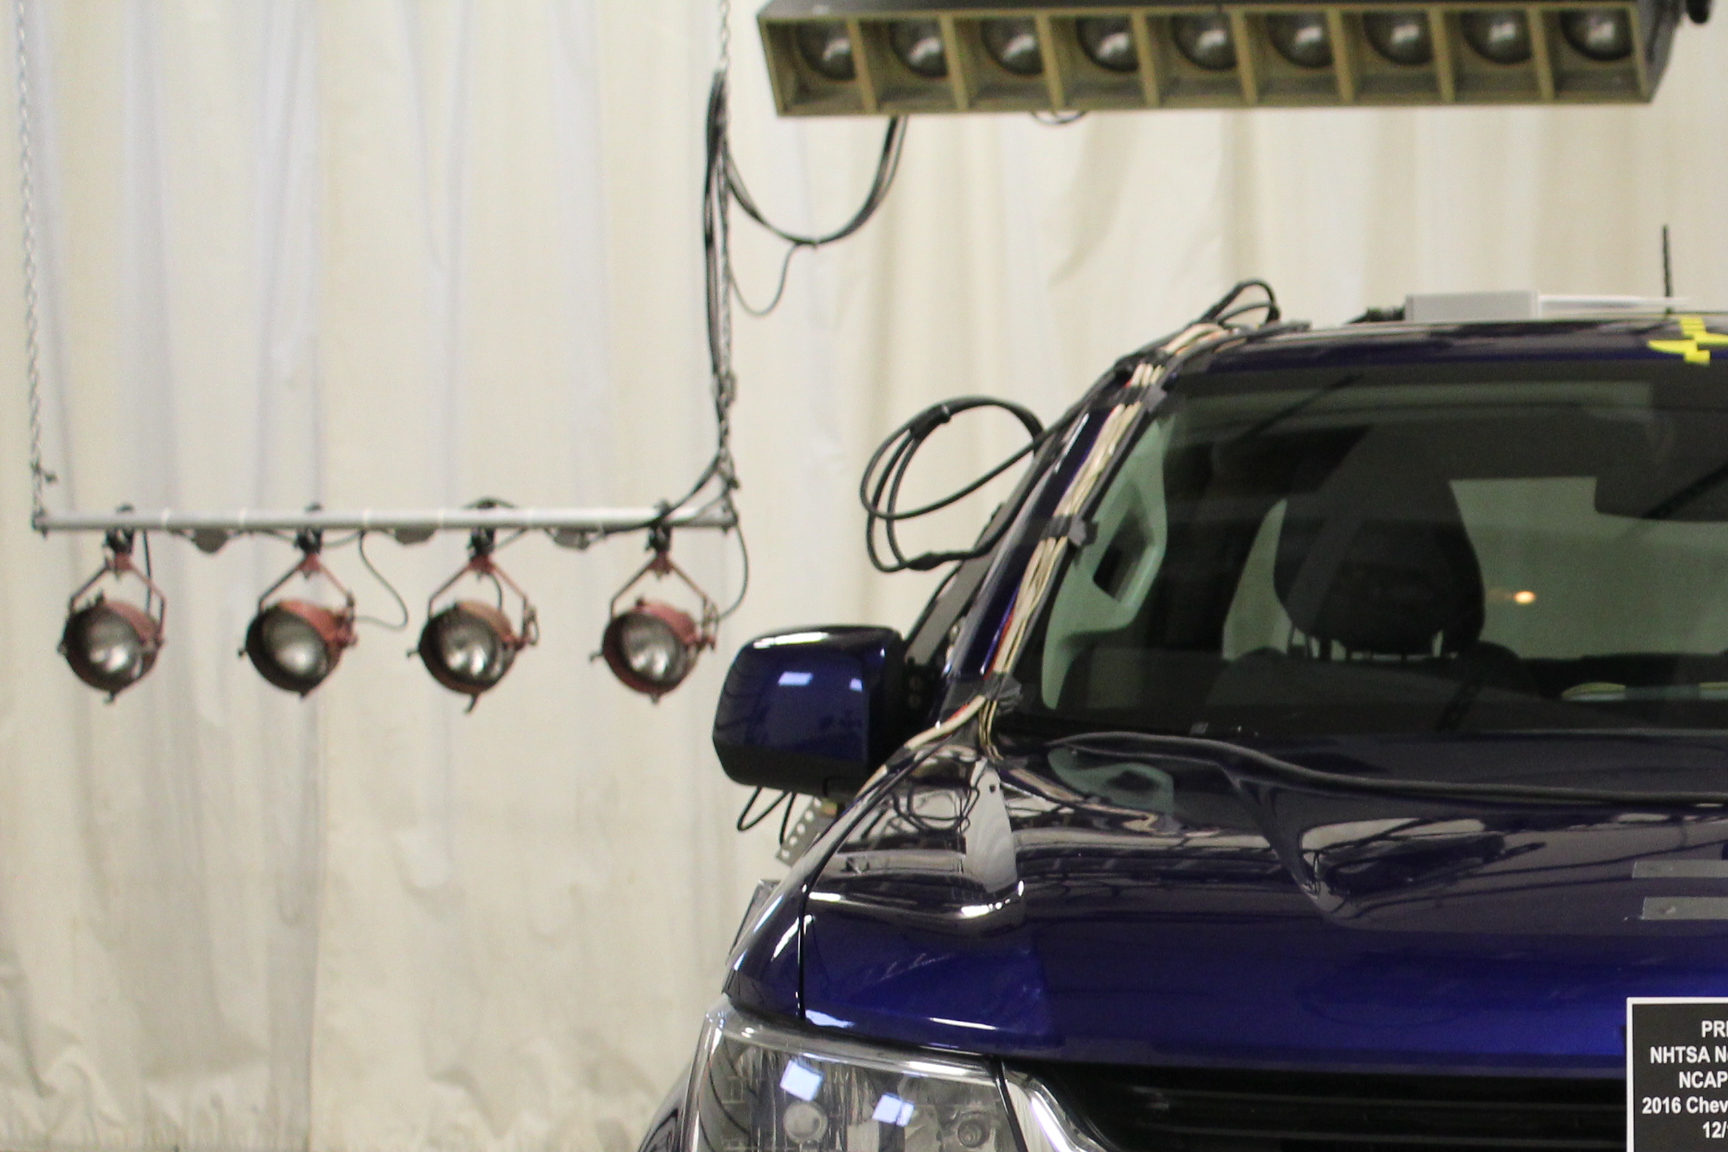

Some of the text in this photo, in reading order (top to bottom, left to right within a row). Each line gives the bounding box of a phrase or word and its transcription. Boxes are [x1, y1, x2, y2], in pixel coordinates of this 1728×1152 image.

[1649, 1045, 1711, 1064] NHTSA
[1678, 1070, 1728, 1089] NCAP
[1641, 1096, 1682, 1115] 2016
